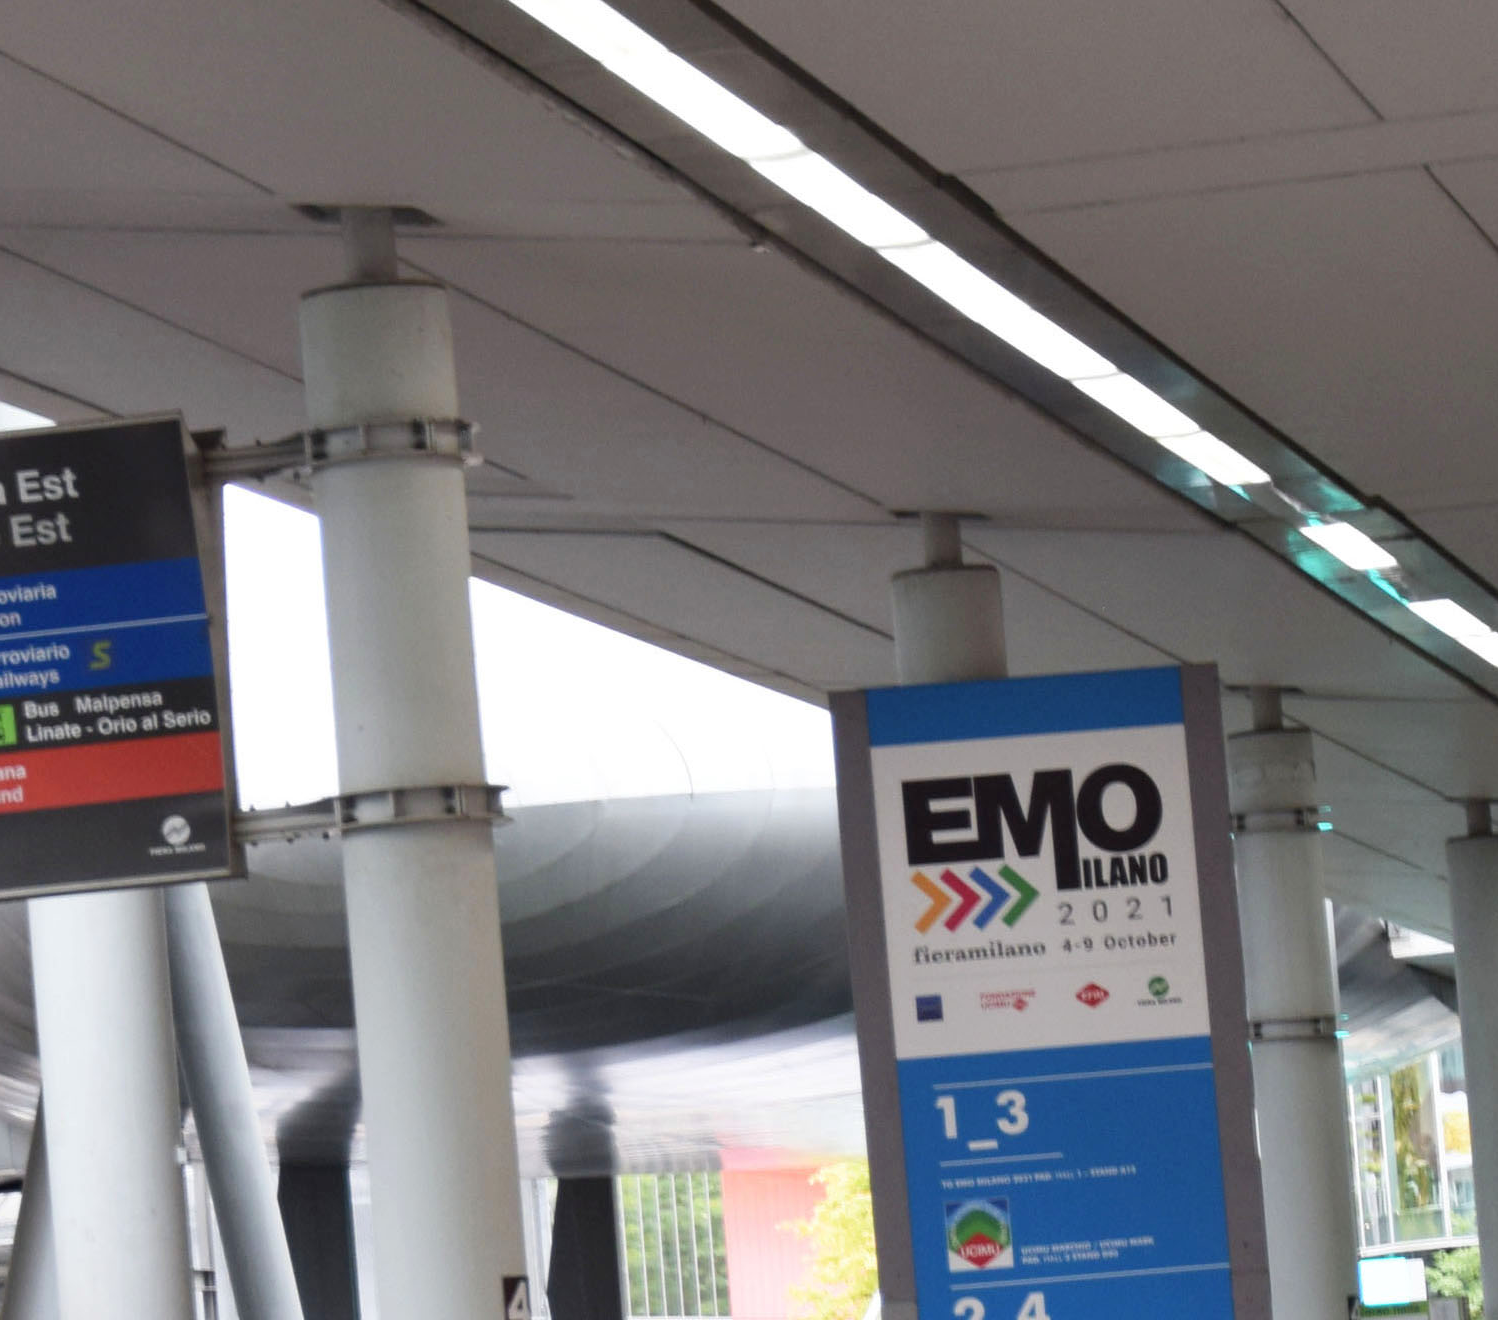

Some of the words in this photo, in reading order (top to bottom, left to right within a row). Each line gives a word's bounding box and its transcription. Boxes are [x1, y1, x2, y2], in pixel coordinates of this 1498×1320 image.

[17, 467, 80, 507] Est
[11, 512, 72, 547] Est
[24, 700, 60, 720] Bus
[75, 689, 164, 716] Malpensa
[25, 720, 81, 743] Linate
[97, 714, 137, 737] Orio
[142, 712, 160, 732] al
[164, 708, 212, 731] Serio
[902, 763, 1163, 891] EMO
[913, 941, 1047, 966] fieramilano
[1104, 932, 1177, 950] October
